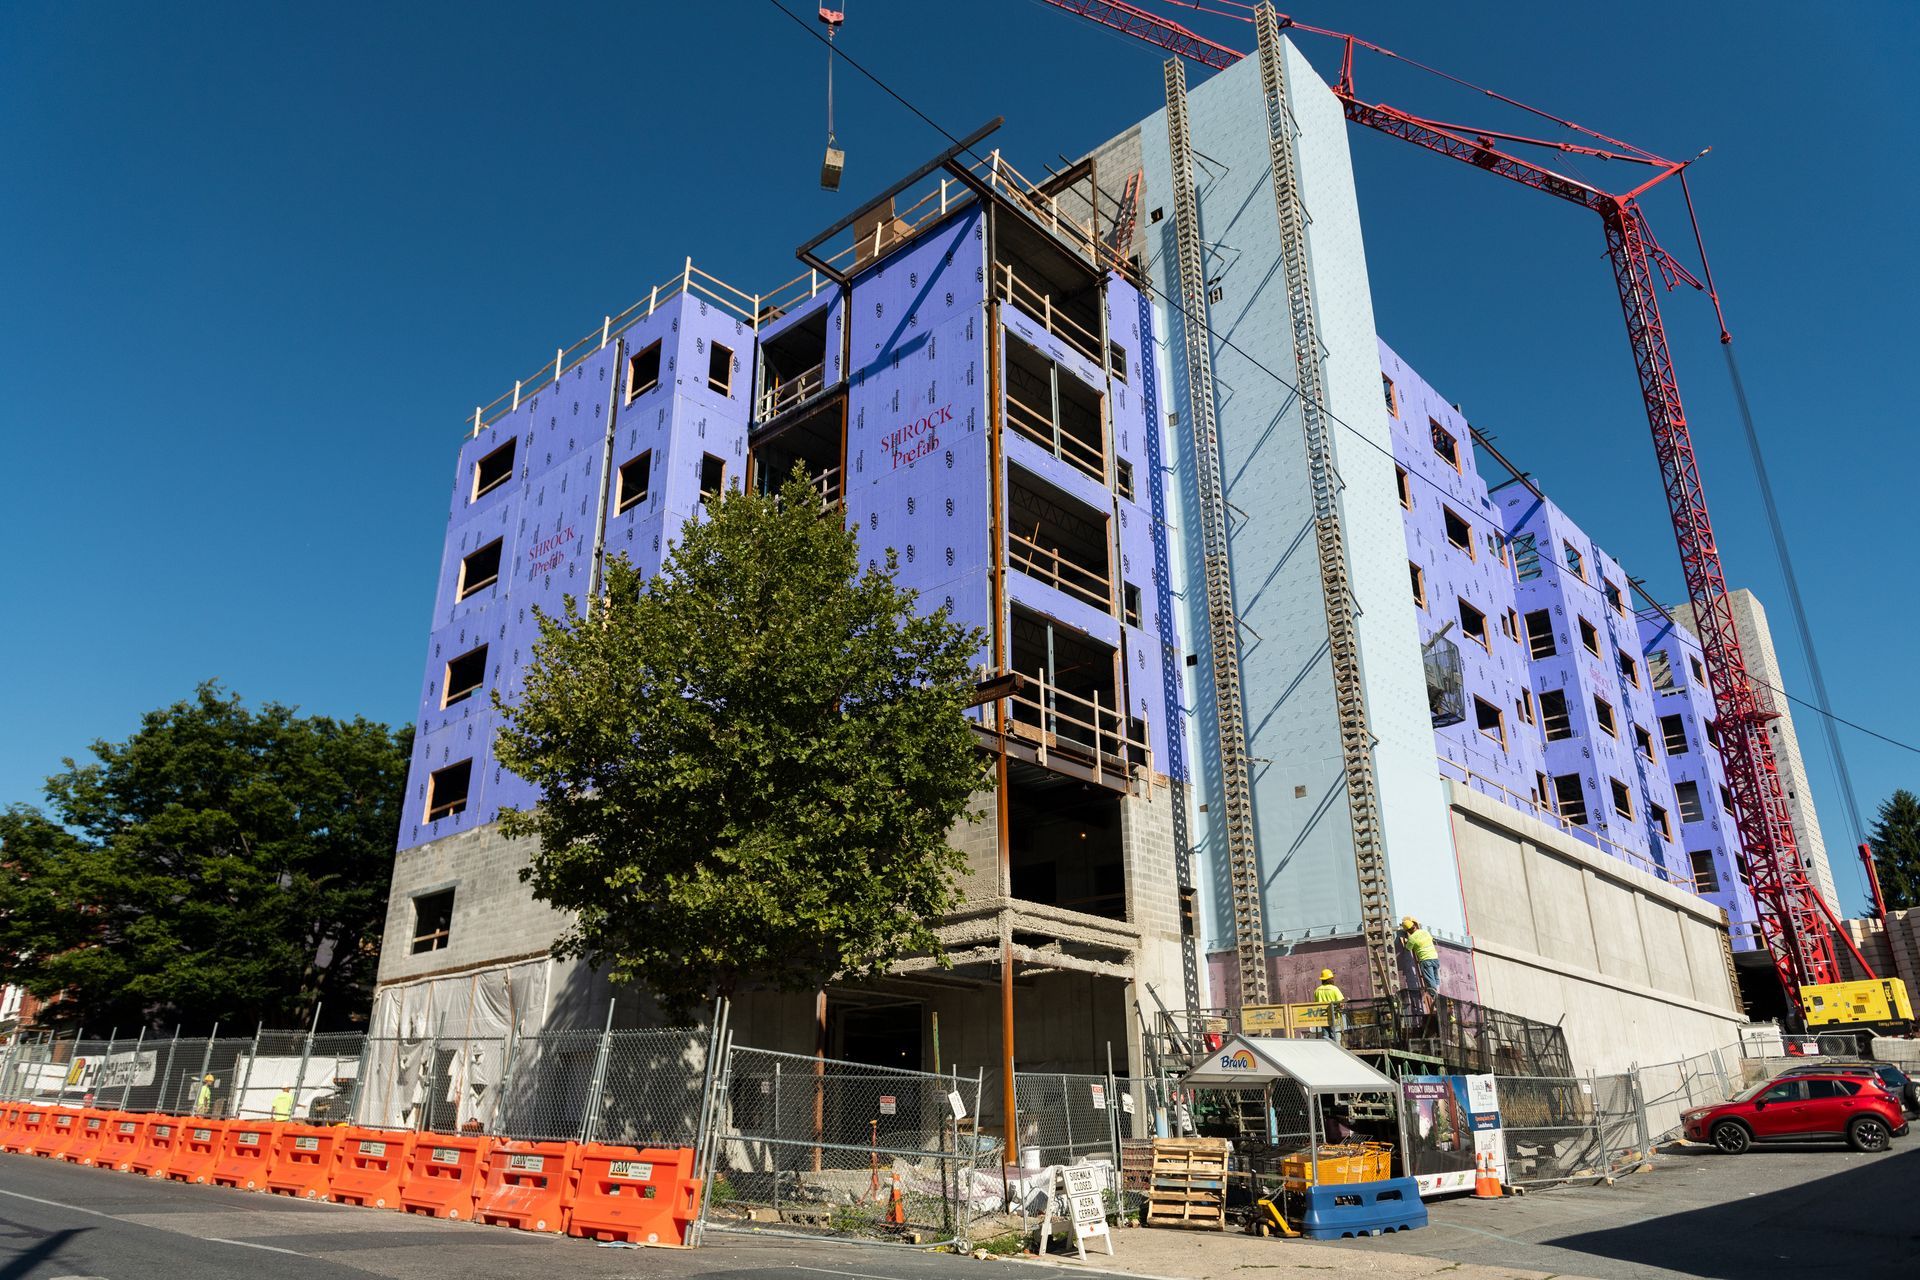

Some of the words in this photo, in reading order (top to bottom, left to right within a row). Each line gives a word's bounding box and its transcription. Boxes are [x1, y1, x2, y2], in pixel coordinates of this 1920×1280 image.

[881, 403, 953, 453] SHROCK
[893, 438, 940, 470] Prefab
[529, 525, 575, 561] SHROCK
[534, 551, 564, 577] Prefab
[1220, 1055, 1248, 1068] Bravo
[611, 1161, 631, 1173] T&W
[1069, 1170, 1092, 1181] SIDEWALK
[1074, 1181, 1092, 1191] CLOSED
[1079, 1197, 1095, 1207] ACERA
[1079, 1208, 1100, 1219] CERRADA
